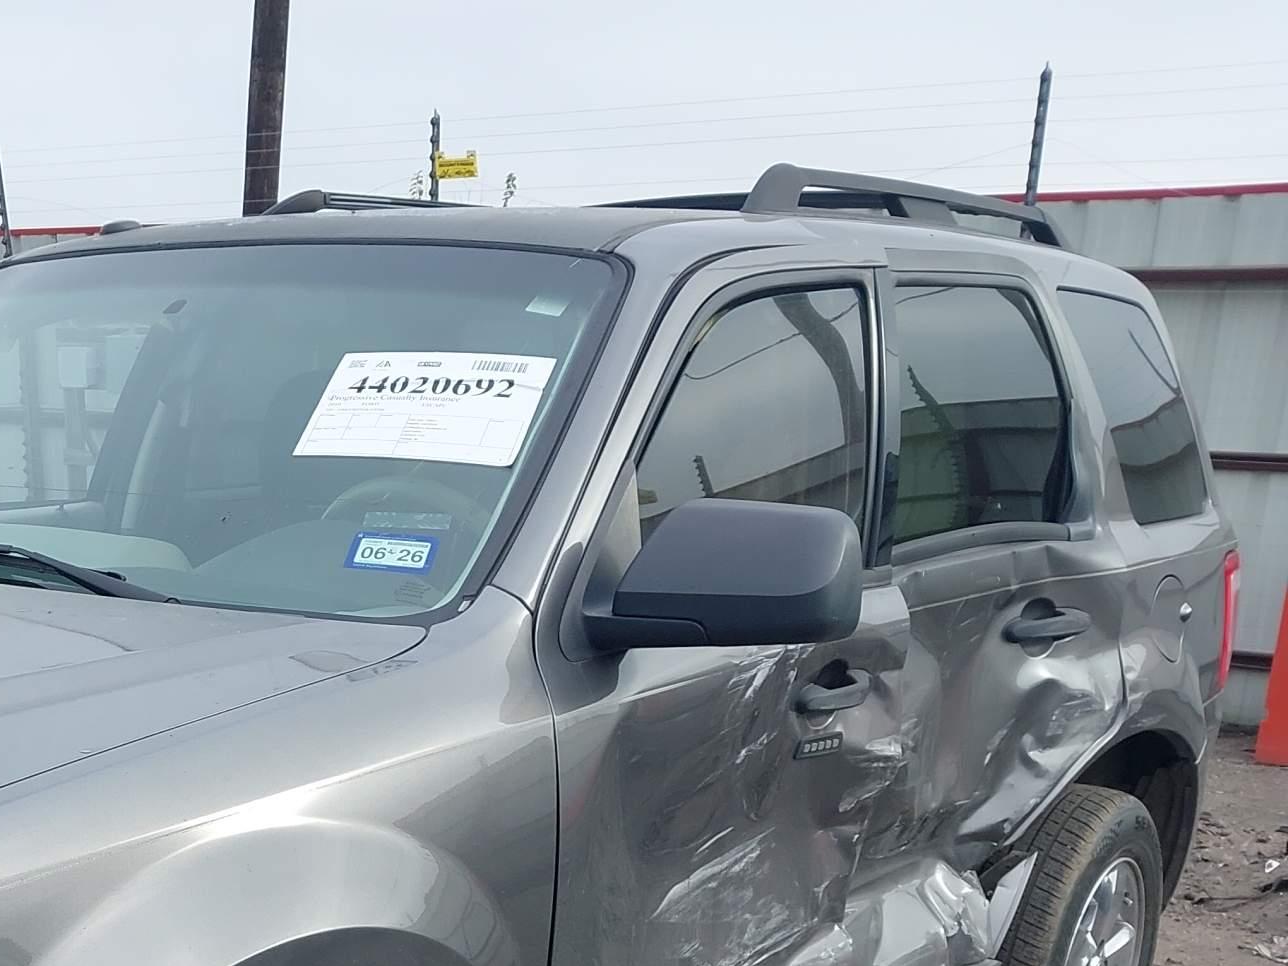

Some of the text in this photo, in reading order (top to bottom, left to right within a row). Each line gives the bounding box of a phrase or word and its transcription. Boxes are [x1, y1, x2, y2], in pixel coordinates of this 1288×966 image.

[347, 375, 515, 399] 44020692
[328, 394, 379, 402] Progressive
[380, 394, 417, 403] Casualty
[360, 546, 425, 563] 06 26
